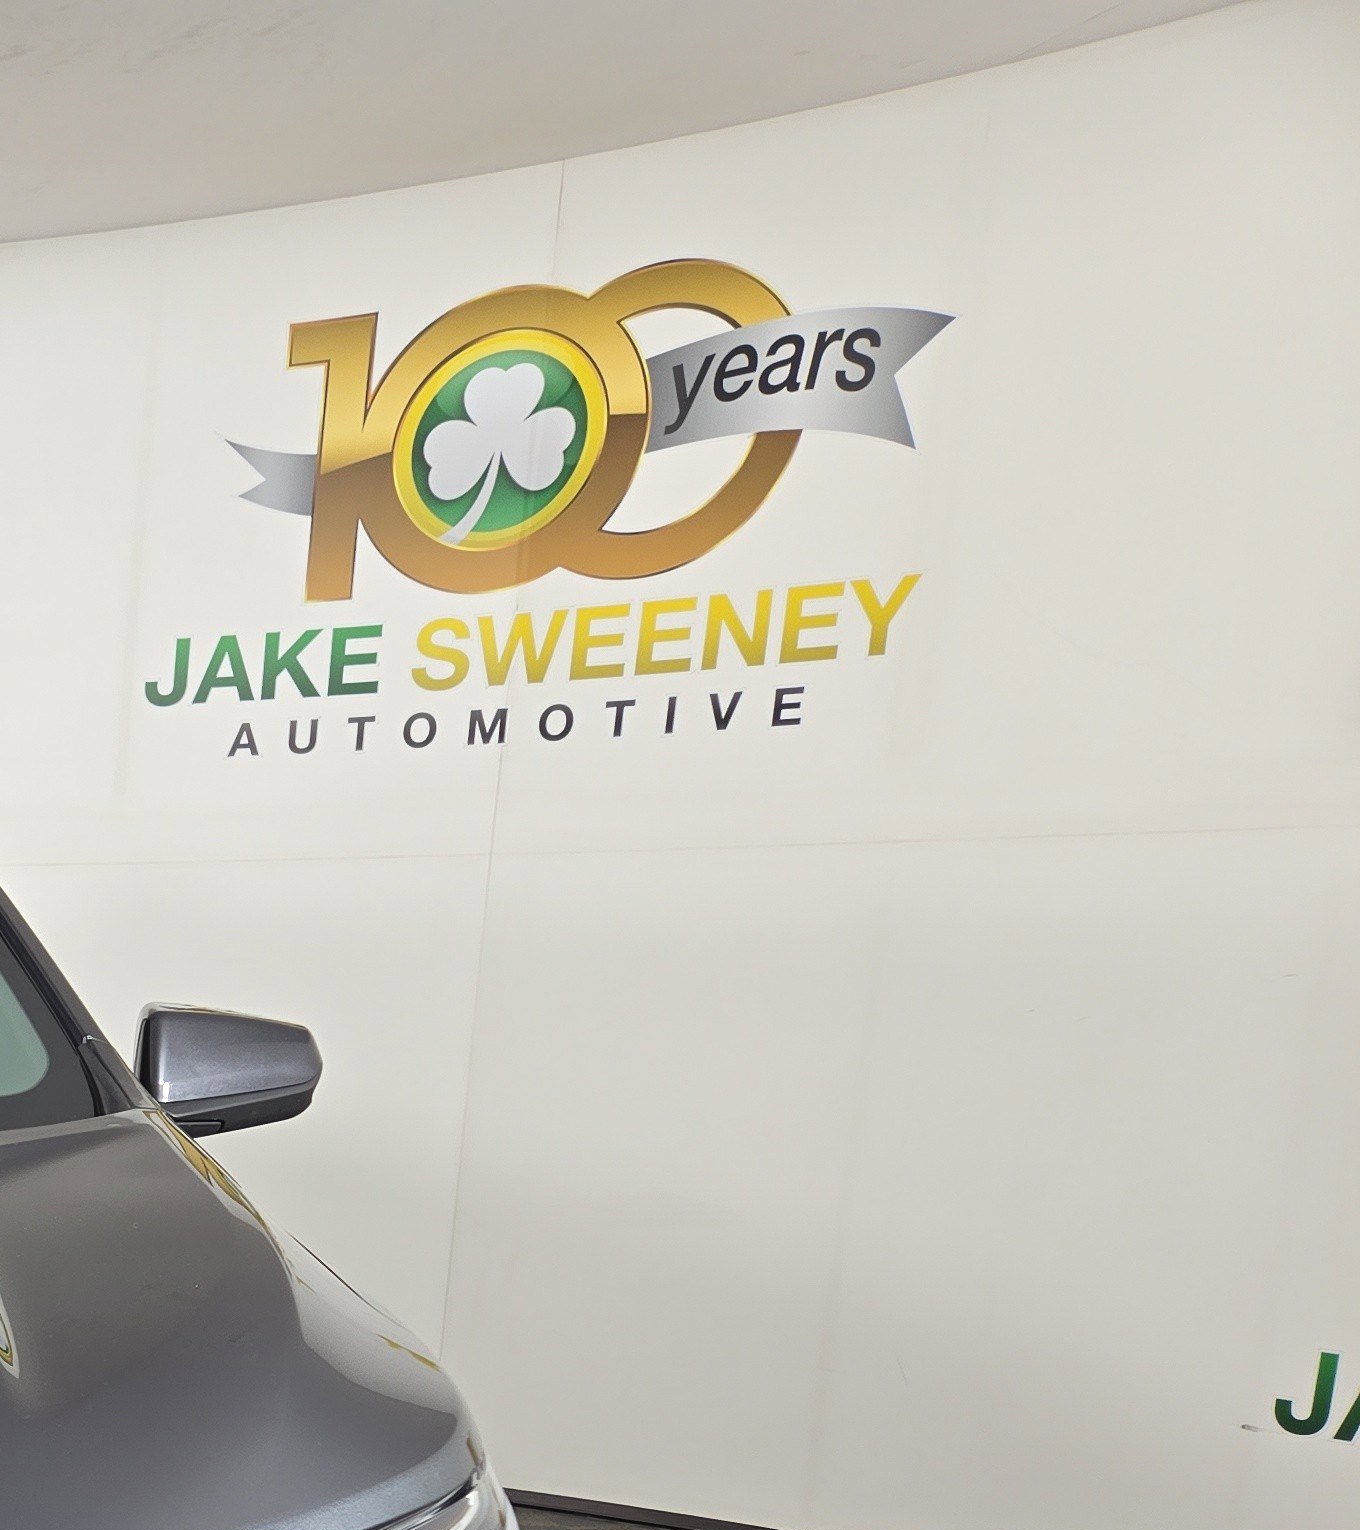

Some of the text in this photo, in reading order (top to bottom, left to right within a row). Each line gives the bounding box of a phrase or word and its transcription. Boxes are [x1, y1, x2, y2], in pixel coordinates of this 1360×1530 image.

[287, 257, 804, 602] 100
[663, 326, 882, 434] years
[143, 572, 923, 708] JAKE SWEENEY
[226, 686, 806, 758] AUTOMOTIVE
